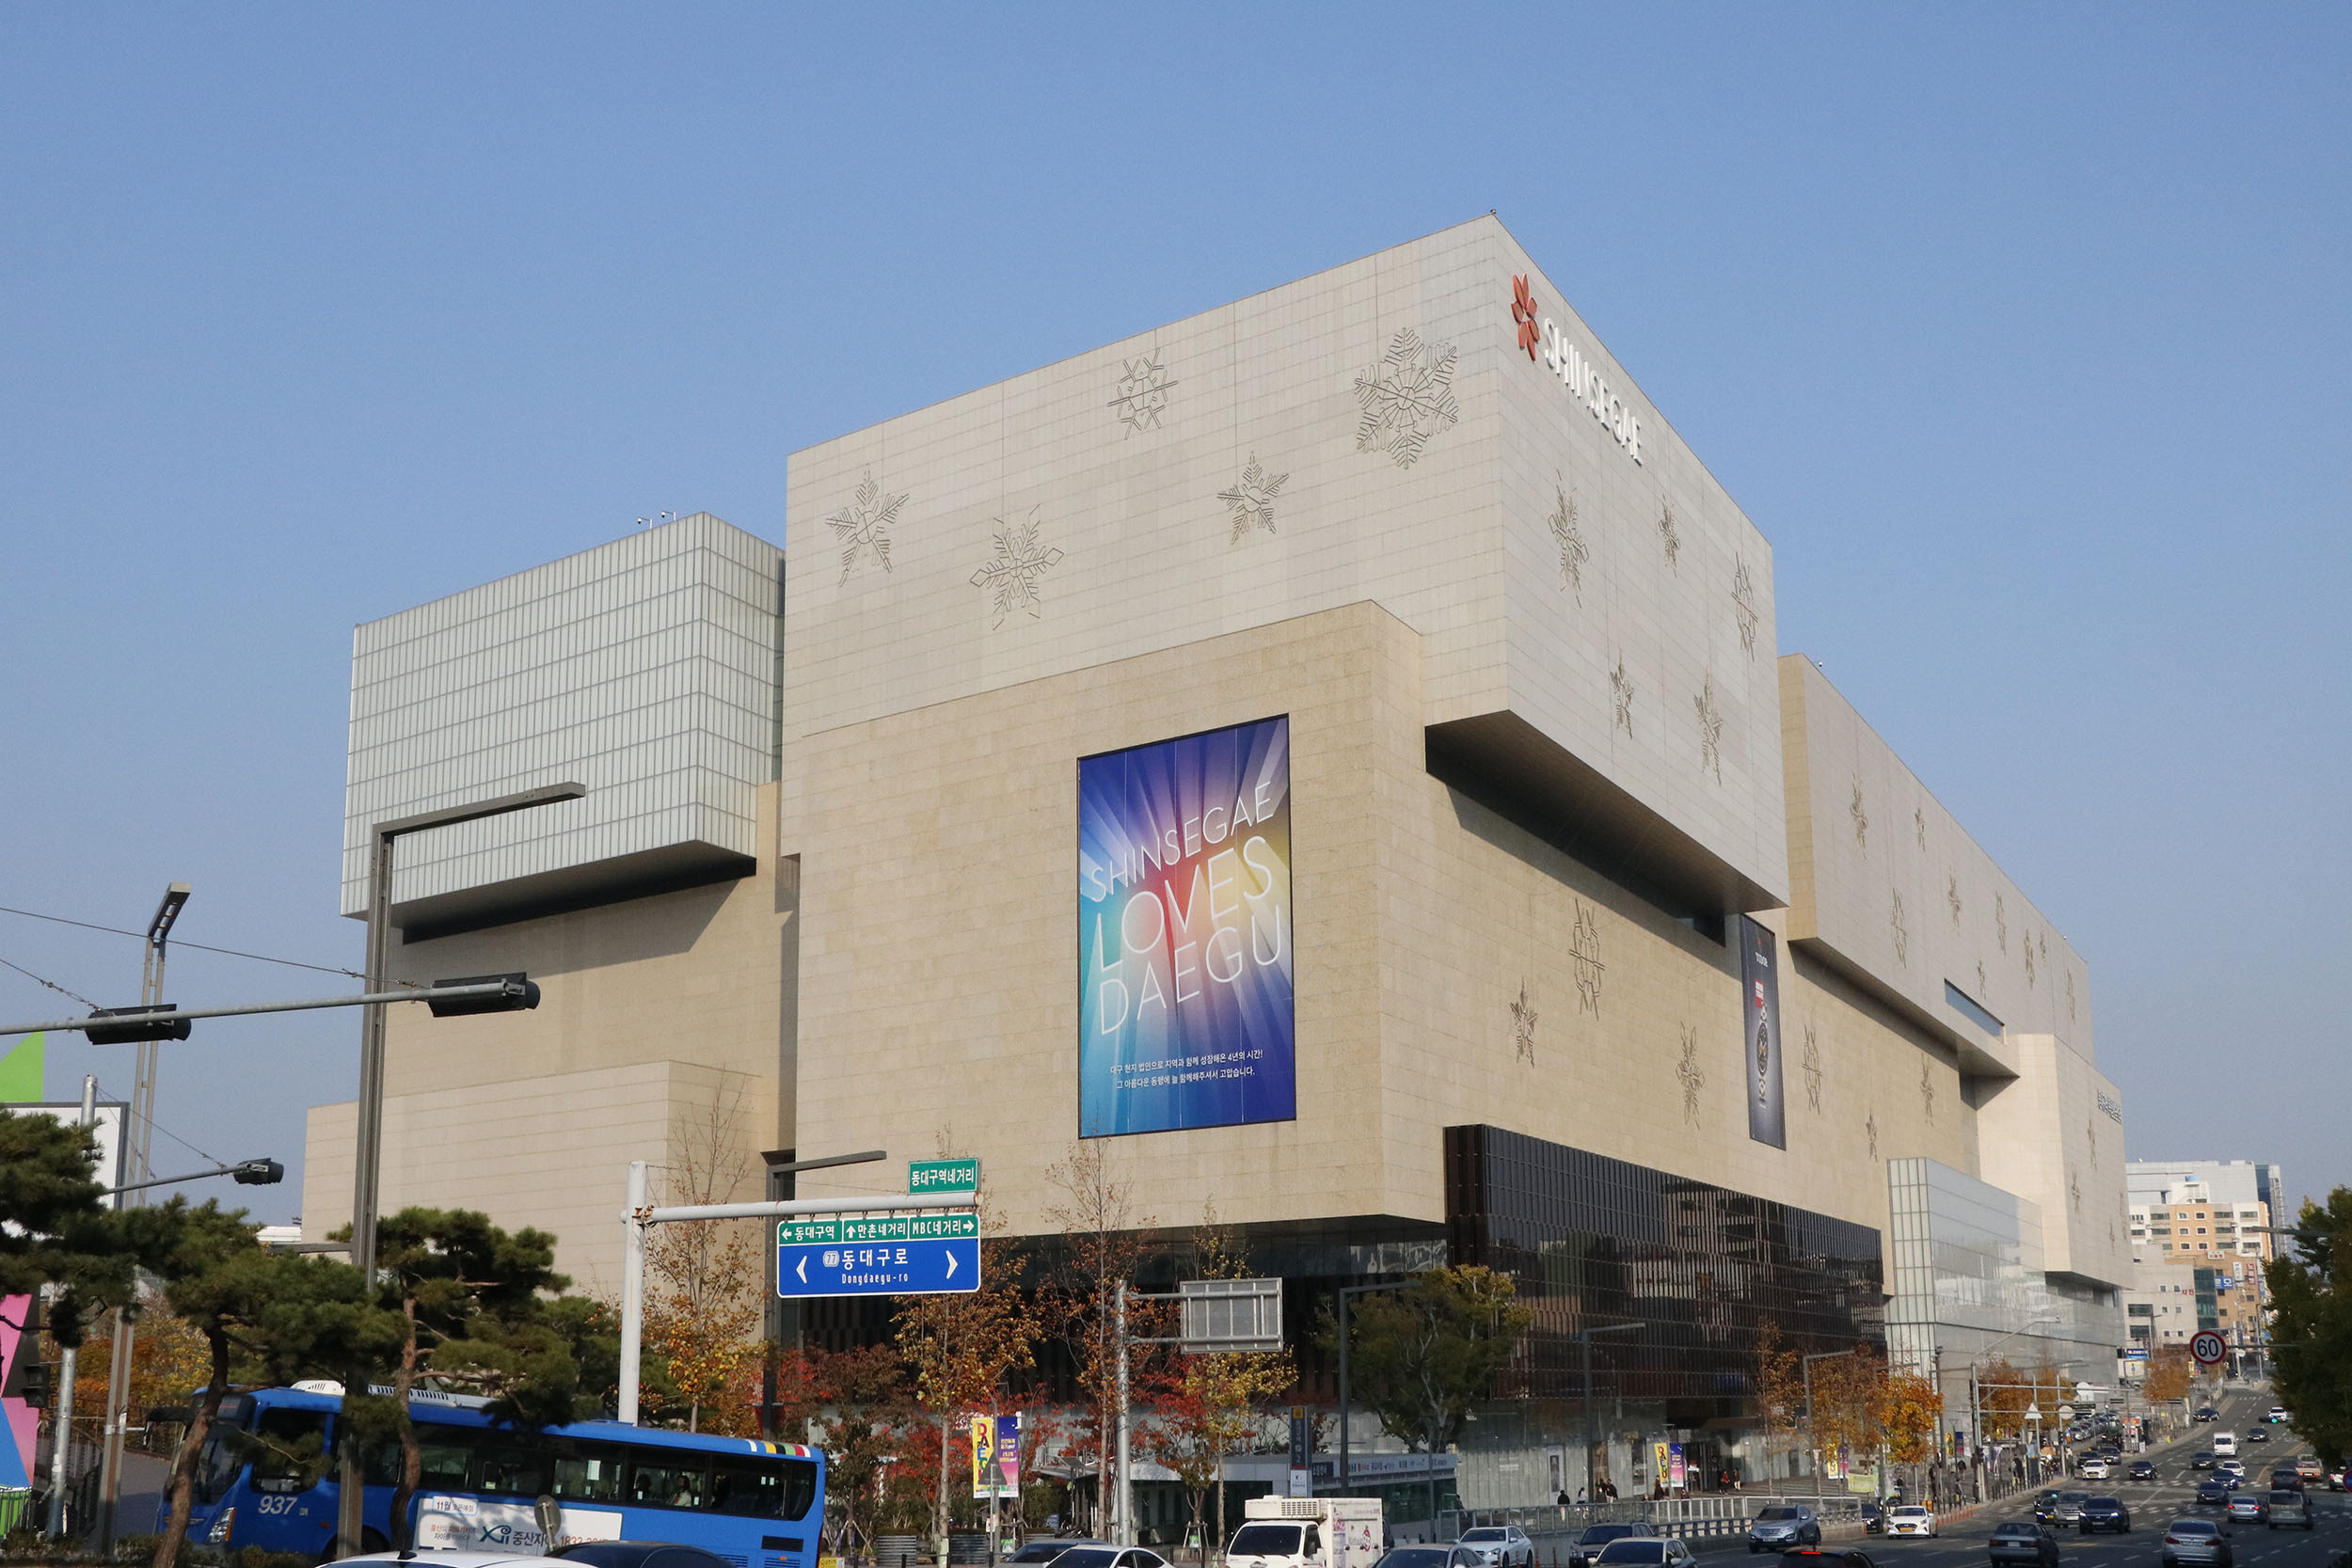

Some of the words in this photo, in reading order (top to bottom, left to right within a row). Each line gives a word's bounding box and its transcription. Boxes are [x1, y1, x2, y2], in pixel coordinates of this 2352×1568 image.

[1545, 317, 1643, 467] SHINSEGAE
[1091, 781, 1274, 903] SHINSEGAE
[1097, 834, 1273, 973] LOVES
[1100, 904, 1281, 1036] DAEGU
[1200, 1053, 1227, 1065] 성장해온
[1228, 1051, 1246, 1062] 4년의
[1247, 1049, 1263, 1059] 시간!
[911, 1166, 975, 1186] 동대구역네거리
[794, 1226, 835, 1242] 동대구역
[857, 1223, 906, 1239] 만촌네거리
[912, 1219, 961, 1236] MBC네거리
[841, 1248, 909, 1271] 동대구로
[841, 1273, 909, 1287] Dongdaegu-ro
[2197, 1338, 2219, 1357] 60
[258, 1495, 298, 1514] 937
[437, 1500, 452, 1512] 11월
